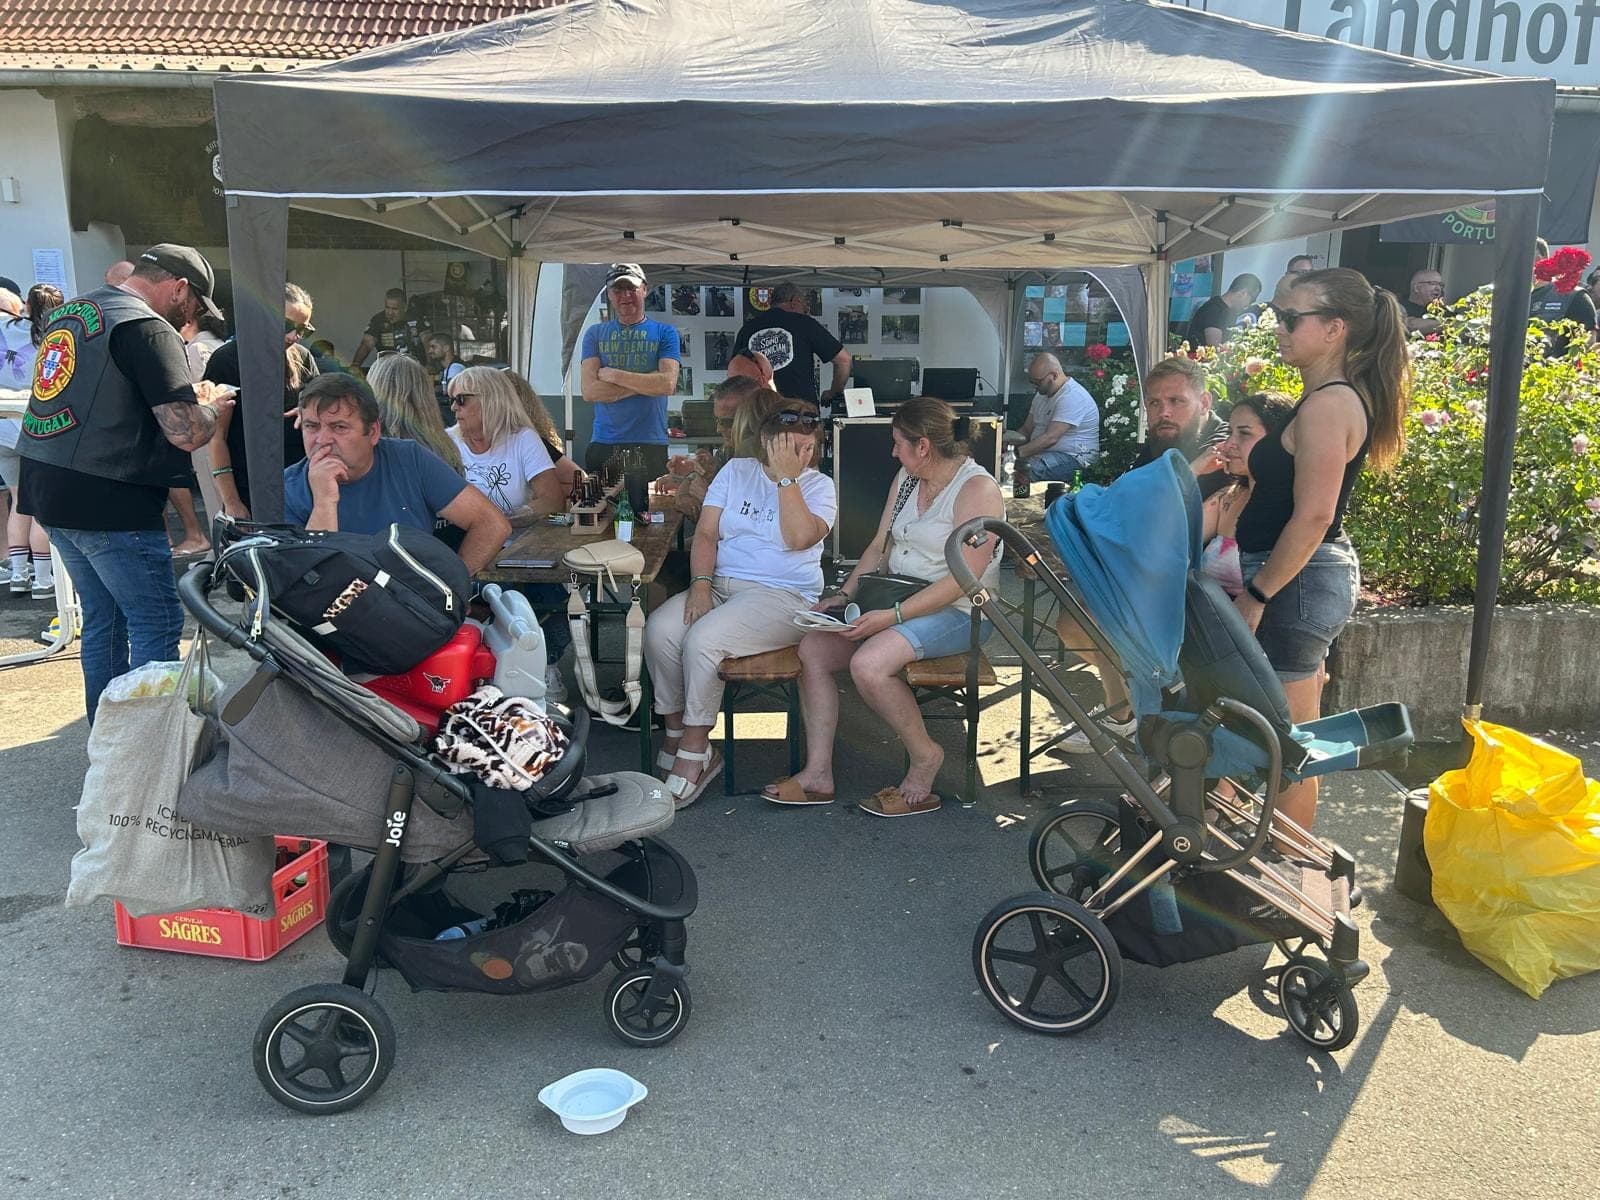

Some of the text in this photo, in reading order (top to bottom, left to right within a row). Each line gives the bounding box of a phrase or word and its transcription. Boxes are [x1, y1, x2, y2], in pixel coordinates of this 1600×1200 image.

[1442, 214, 1496, 240] PORTU
[109, 814, 141, 828] 100%
[157, 804, 178, 823] ICH
[385, 811, 406, 847] Joie
[280, 900, 314, 933] SAGRES
[159, 918, 222, 945] SAGRES
